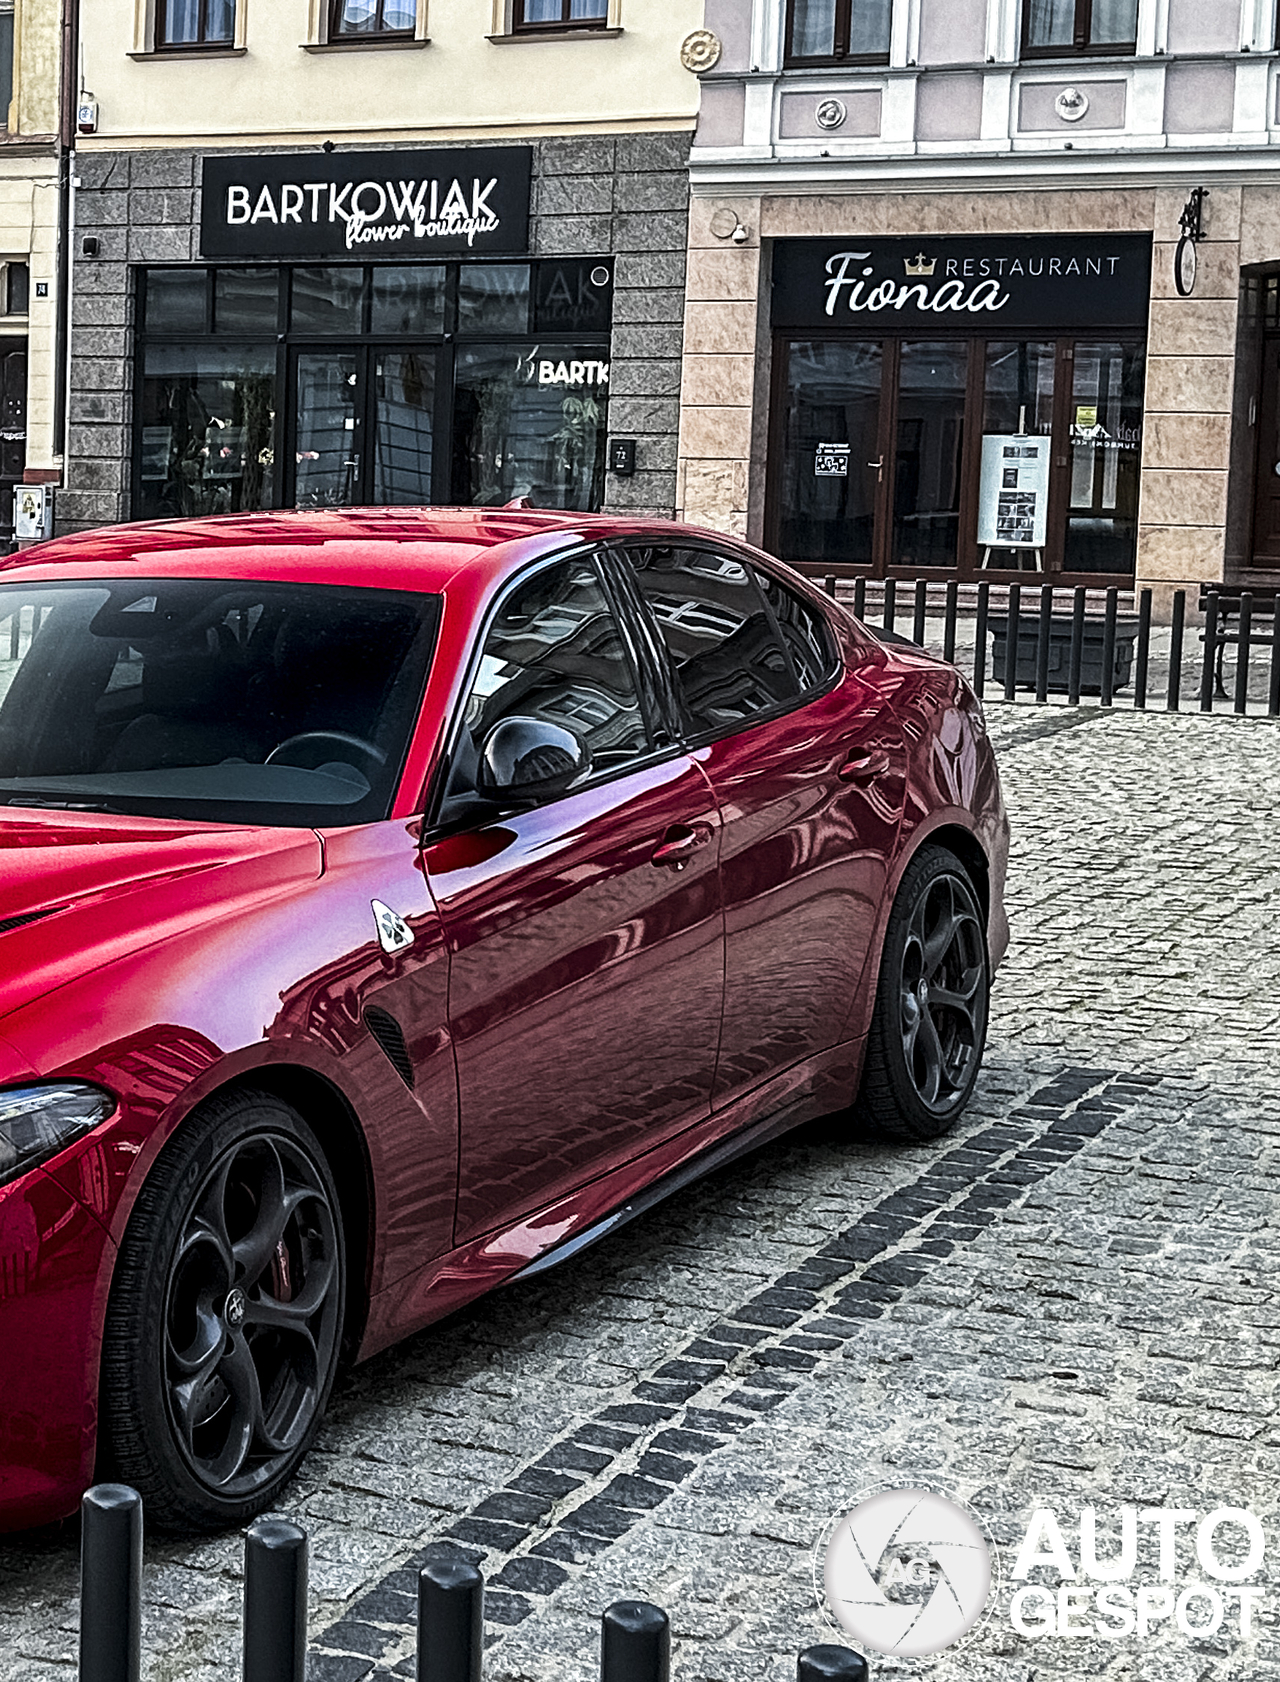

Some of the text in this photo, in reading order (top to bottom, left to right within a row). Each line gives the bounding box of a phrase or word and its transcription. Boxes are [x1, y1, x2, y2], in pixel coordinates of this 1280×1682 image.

[227, 178, 498, 225] BARTKOWIAK
[345, 202, 500, 249] flower boutique
[824, 251, 1010, 316] Fionaa
[946, 256, 1121, 277] RESTAURANT
[538, 360, 609, 385] BARTK
